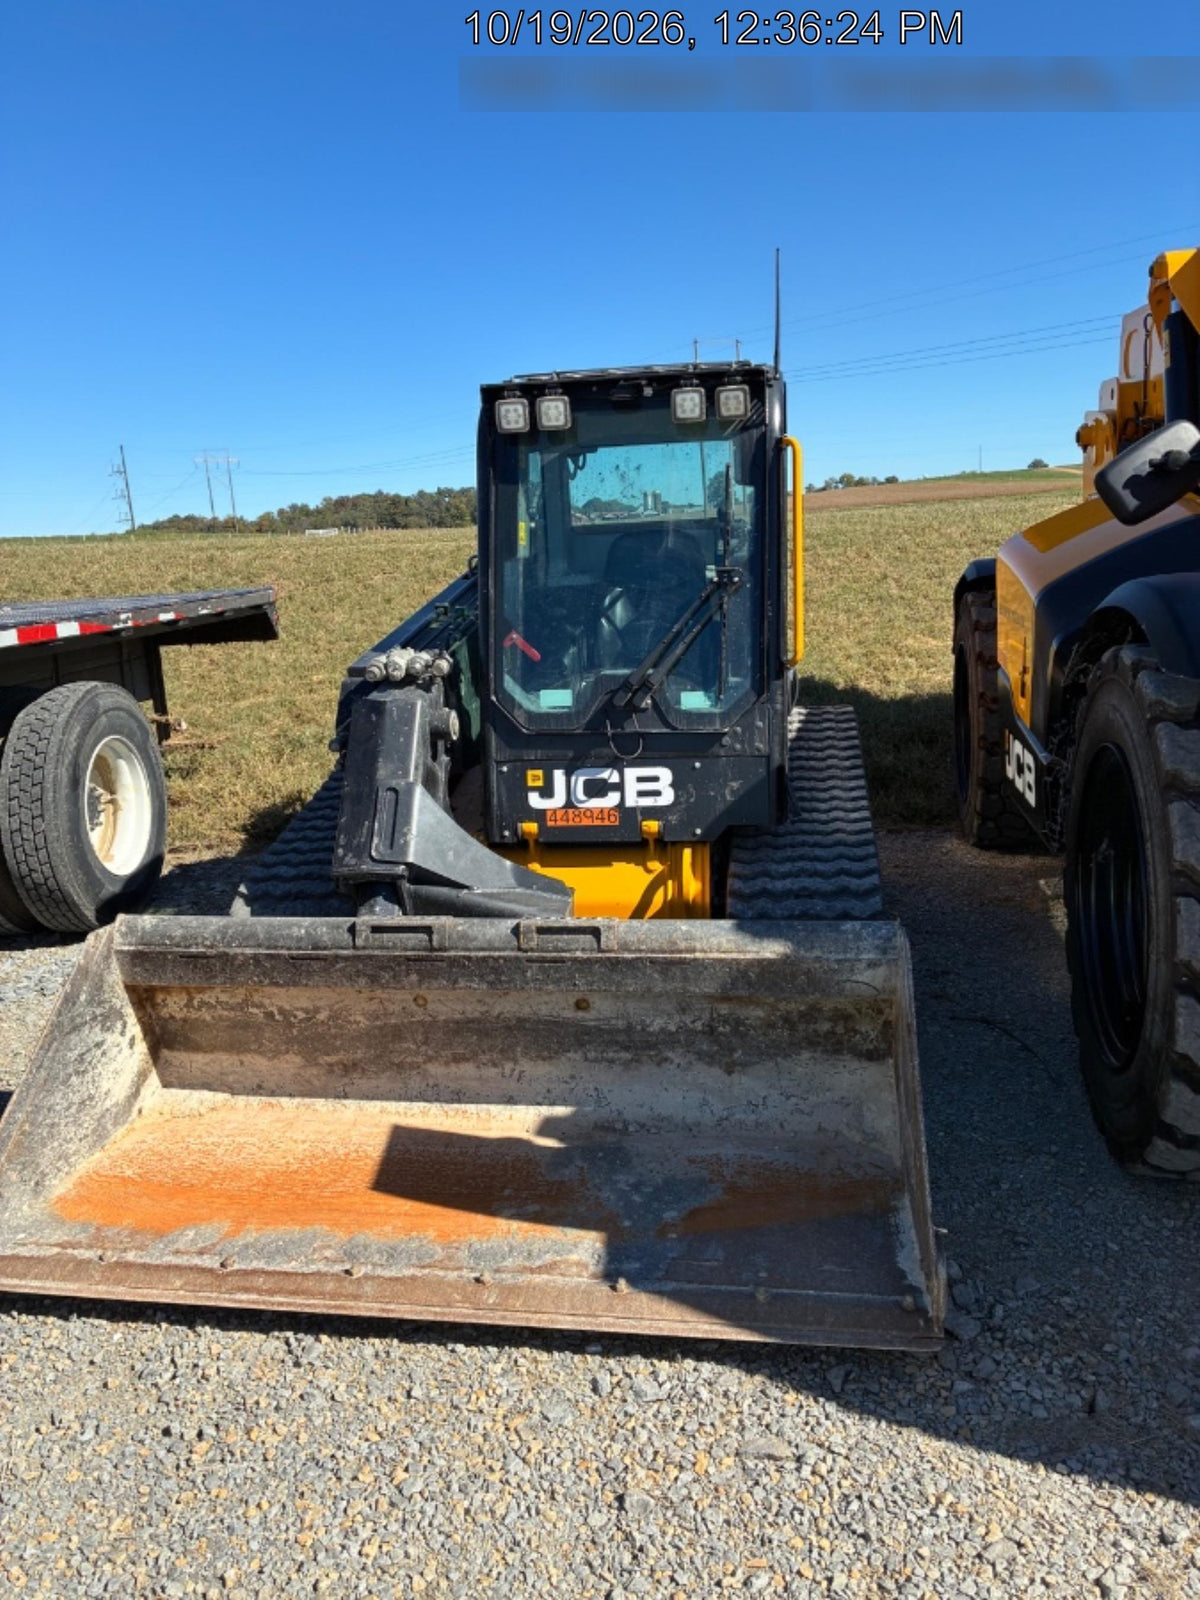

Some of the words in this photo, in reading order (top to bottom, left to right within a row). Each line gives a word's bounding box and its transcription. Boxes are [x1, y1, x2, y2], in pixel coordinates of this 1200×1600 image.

[527, 767, 675, 810] JCB
[1005, 731, 1036, 808] JCB
[549, 808, 618, 825] 448946
